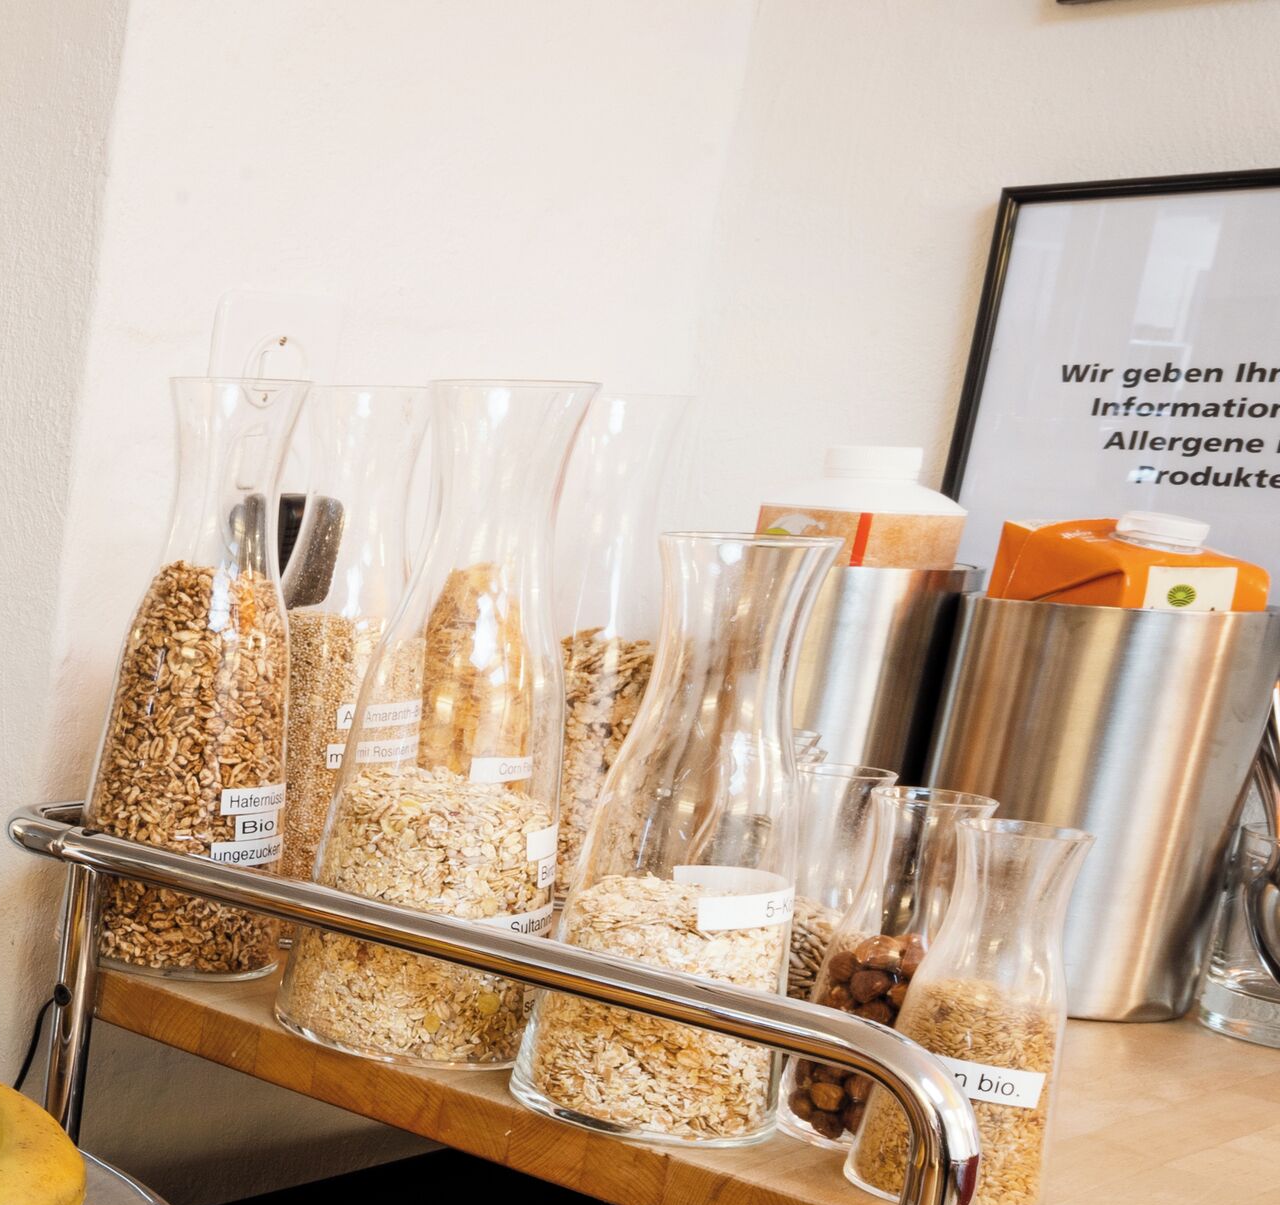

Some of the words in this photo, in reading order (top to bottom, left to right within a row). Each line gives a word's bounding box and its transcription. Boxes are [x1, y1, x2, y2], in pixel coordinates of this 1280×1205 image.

[1061, 363, 1114, 383] Wir
[1122, 362, 1224, 388] geben
[1103, 430, 1264, 457] Allergene
[242, 819, 275, 835] Bio
[978, 1073, 1020, 1098] bio.
